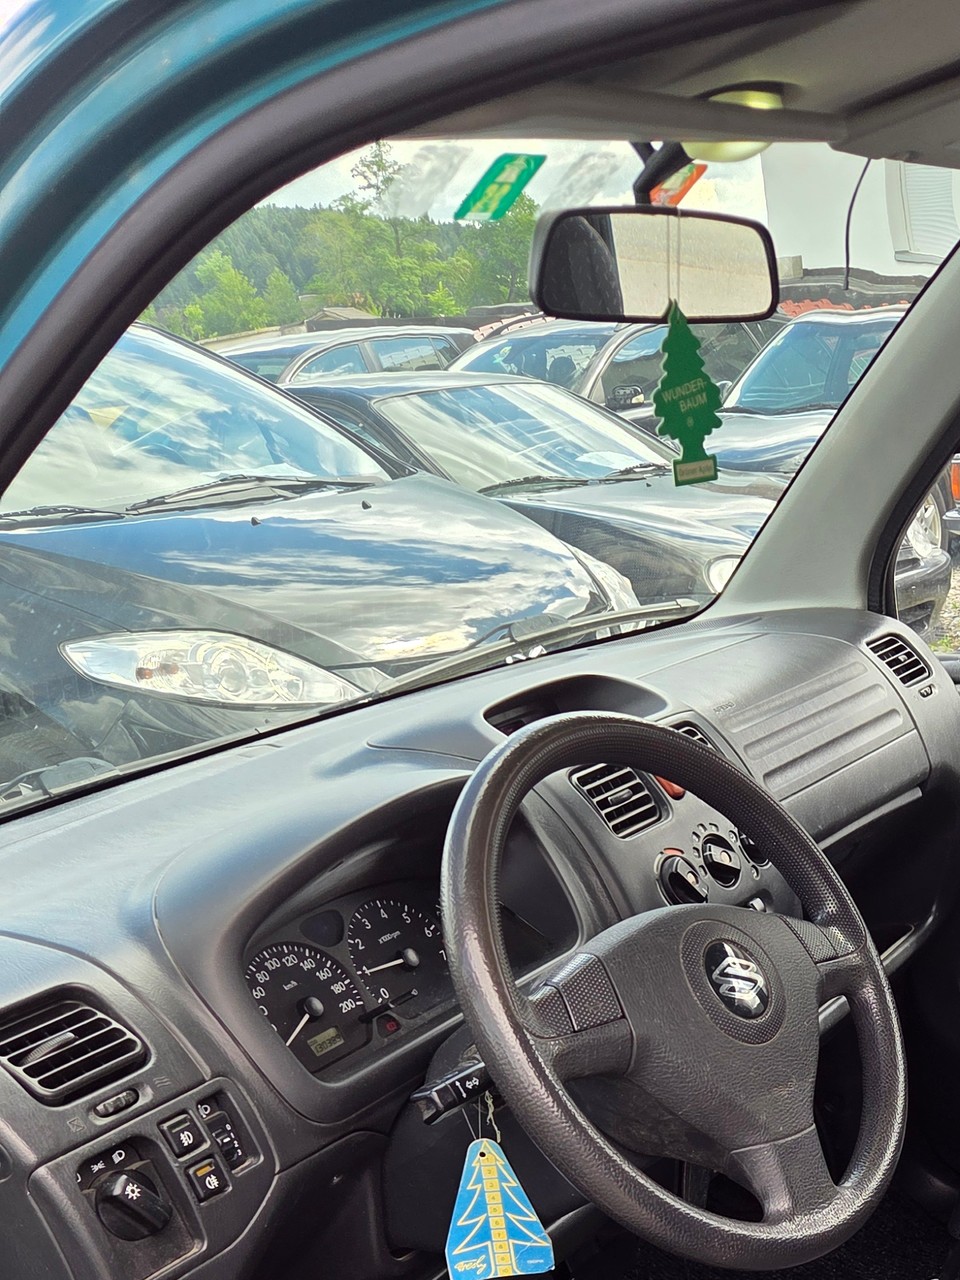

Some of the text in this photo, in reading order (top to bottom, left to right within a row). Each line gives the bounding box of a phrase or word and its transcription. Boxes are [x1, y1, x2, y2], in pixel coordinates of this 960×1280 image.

[661, 378, 707, 404] WUNDER-
[679, 392, 708, 413] BAUM
[380, 908, 388, 919] 4
[402, 912, 411, 924] 5
[361, 918, 371, 930] 3
[424, 927, 433, 938] 6
[354, 938, 365, 950] 2
[282, 954, 298, 967] 120
[439, 950, 447, 961] 7
[264, 957, 281, 971] 100
[299, 958, 316, 971] 140
[255, 970, 269, 984] 80
[315, 967, 332, 981] 160
[252, 986, 266, 999] 60
[330, 981, 346, 995] 180
[379, 988, 389, 999] 0
[338, 998, 356, 1014] 200
